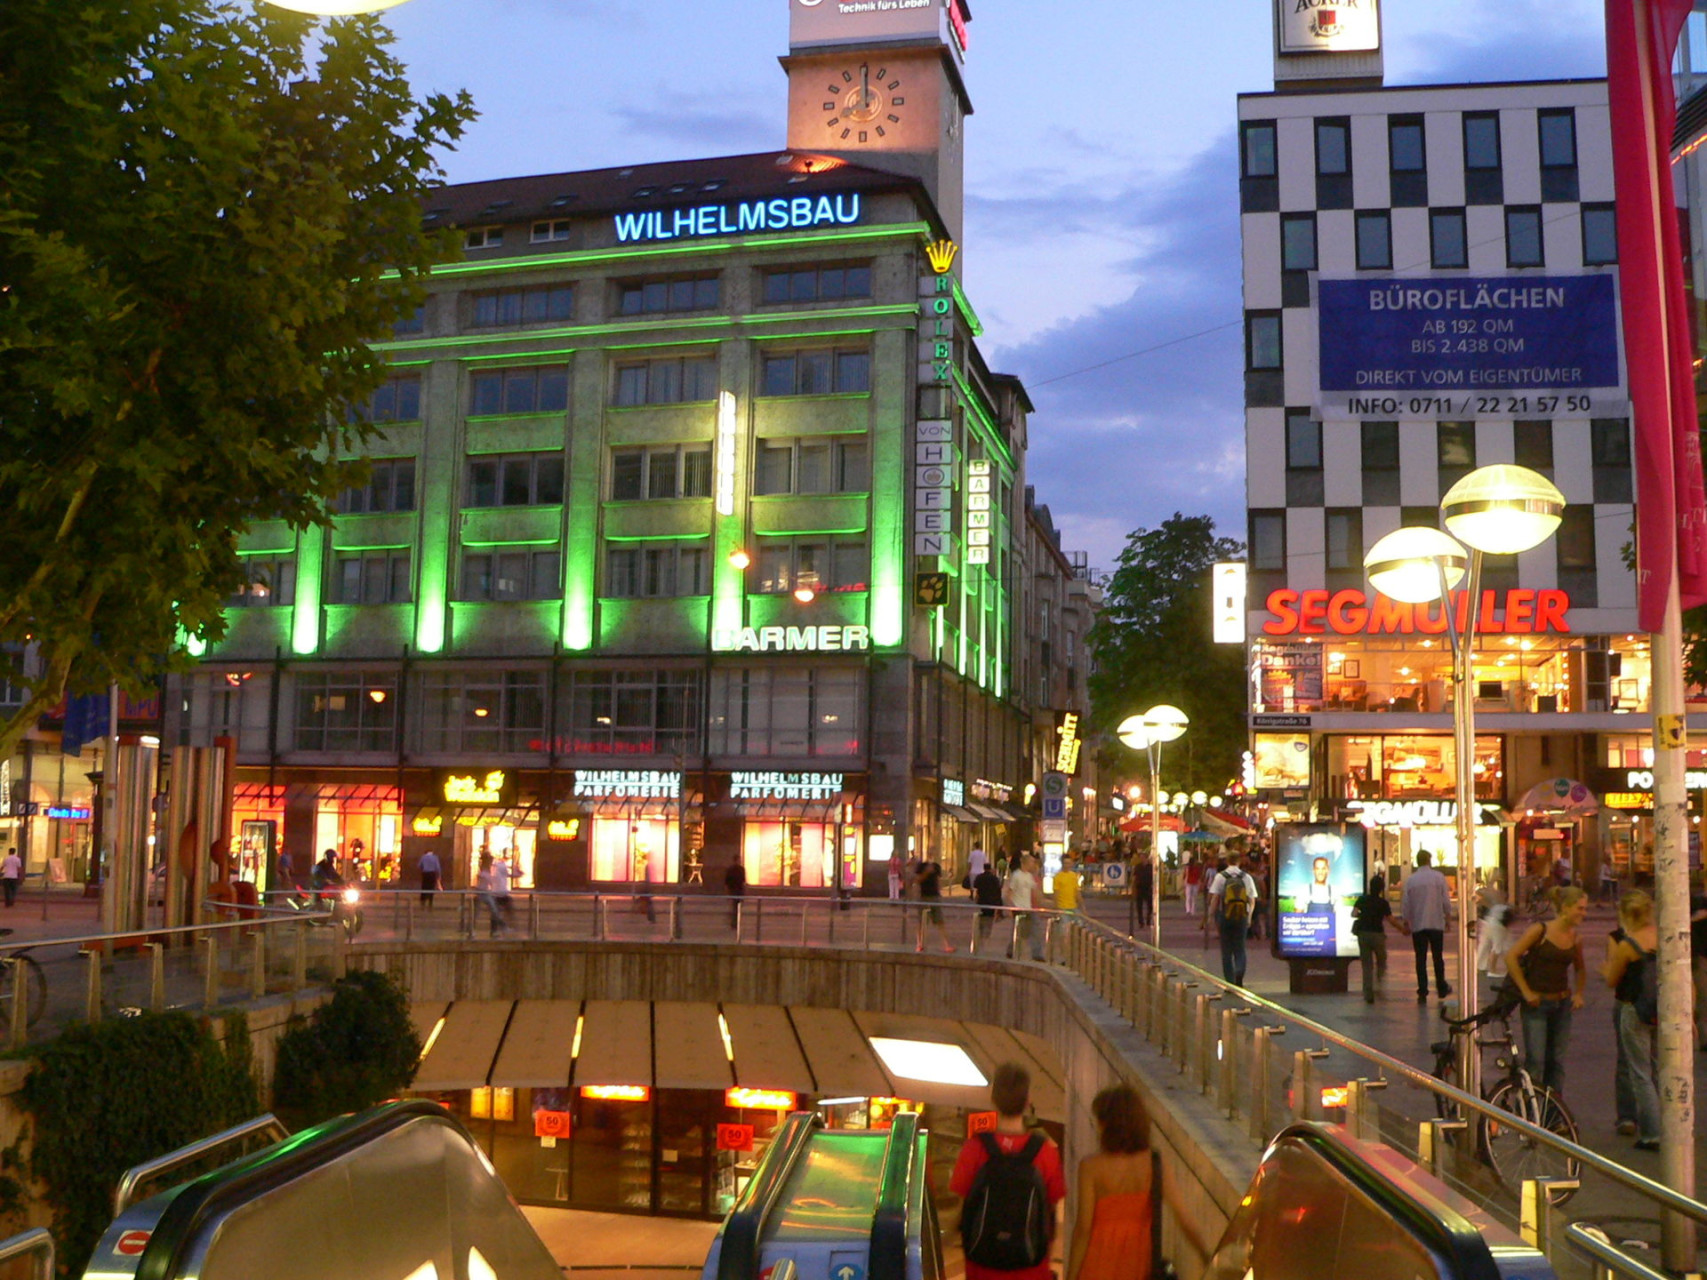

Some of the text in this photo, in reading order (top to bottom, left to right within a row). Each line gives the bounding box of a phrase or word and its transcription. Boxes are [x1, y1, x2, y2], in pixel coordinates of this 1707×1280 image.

[838, 3, 876, 14] Technik
[877, 1, 898, 11] fürs
[615, 193, 860, 242] WILHELMSBAU
[1370, 284, 1565, 311] BÜROFLÄCHEN
[934, 276, 948, 381] ROLEX
[1422, 319, 1514, 334] AB 192 QM
[1411, 337, 1525, 353] BIS 2.438 QM
[1356, 366, 1582, 385] DIREKT VOM EIGENTÜMER
[1348, 395, 1591, 415] INFO: 0711 / 22 21 57 50
[918, 425, 951, 437] VON
[973, 461, 987, 563] BARMER
[712, 625, 869, 651] BARMER
[575, 770, 681, 783] WILHELMSBAU
[731, 772, 843, 785] WILHELMSBAU
[1048, 800, 1060, 813] U
[1345, 800, 1483, 825] SEGMÜLLR
[546, 1117, 558, 1126] 50
[728, 1130, 741, 1139] 50
